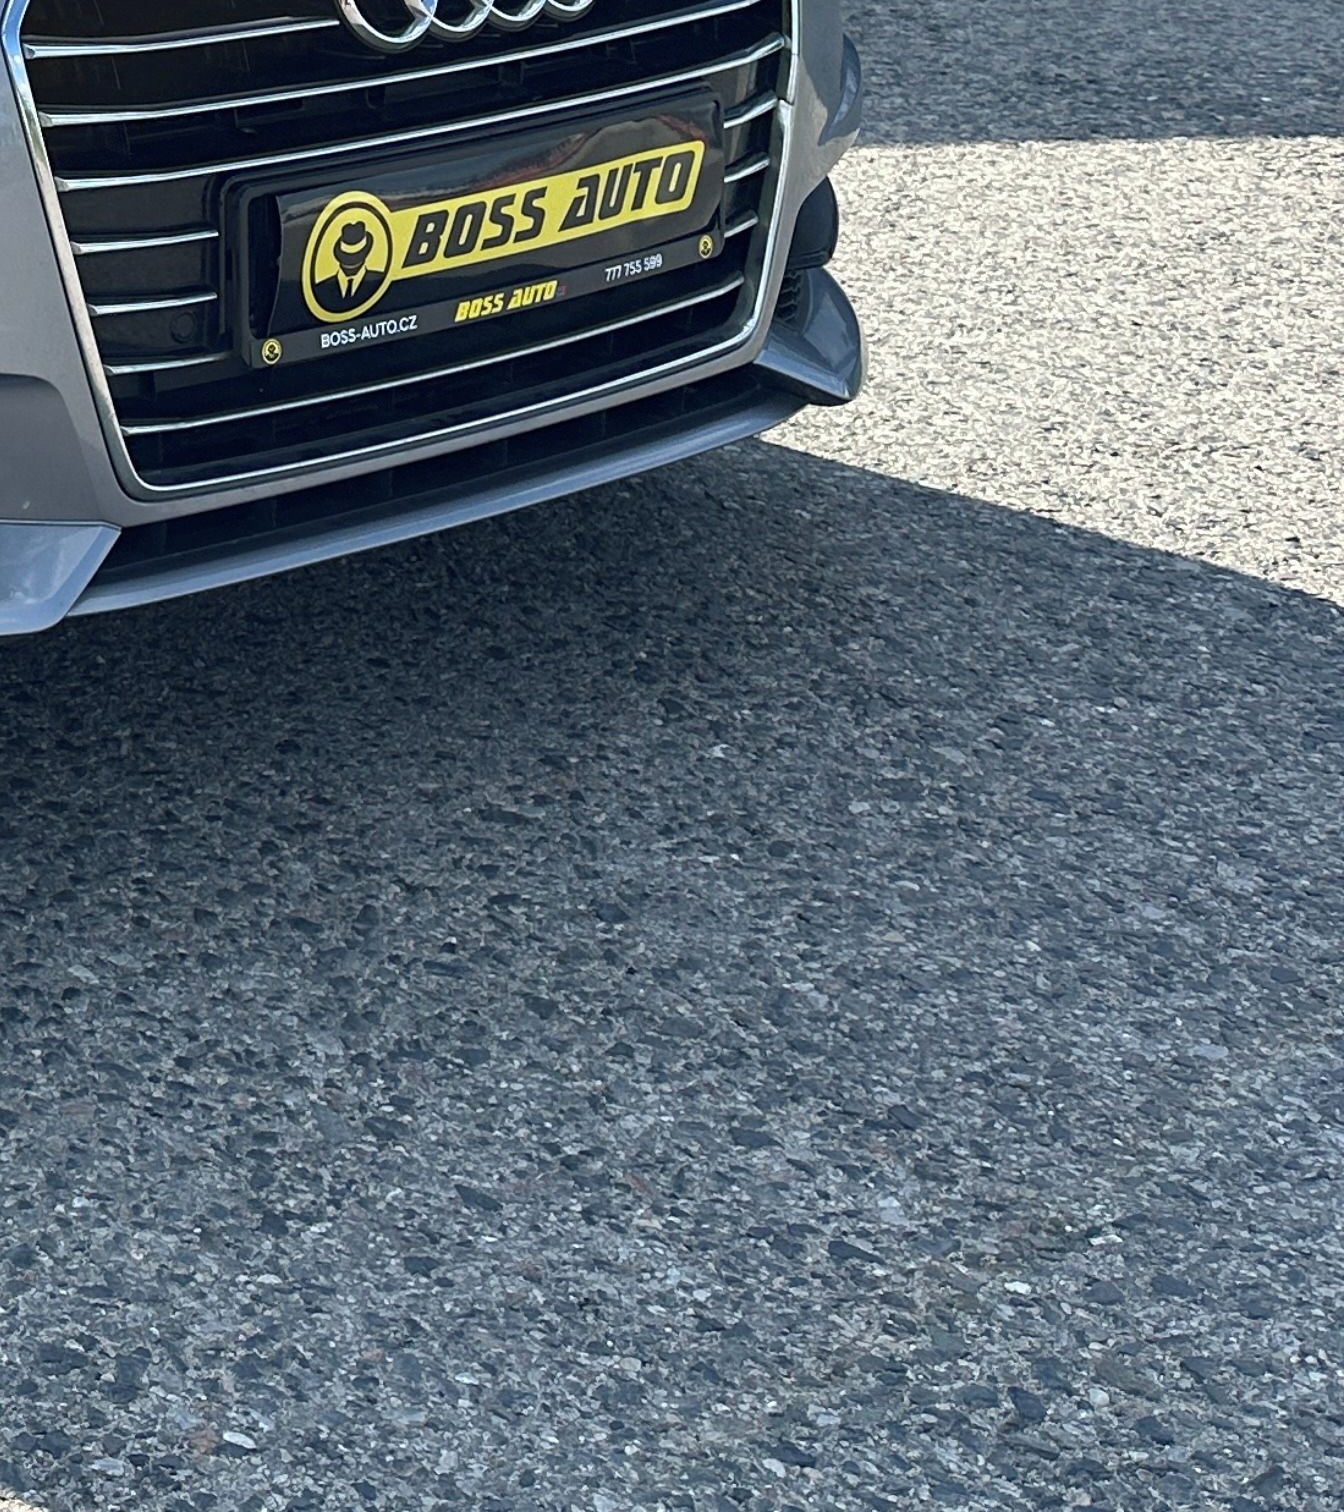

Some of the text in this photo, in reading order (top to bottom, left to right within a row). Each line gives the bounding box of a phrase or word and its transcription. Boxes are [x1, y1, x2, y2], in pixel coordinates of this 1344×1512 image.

[401, 150, 696, 269] BOSS AUTO
[605, 265, 623, 282] 777
[623, 259, 643, 277] 755
[454, 280, 559, 323] BOSS AUTO
[320, 314, 418, 349] BOSS-AUTO.CZ
